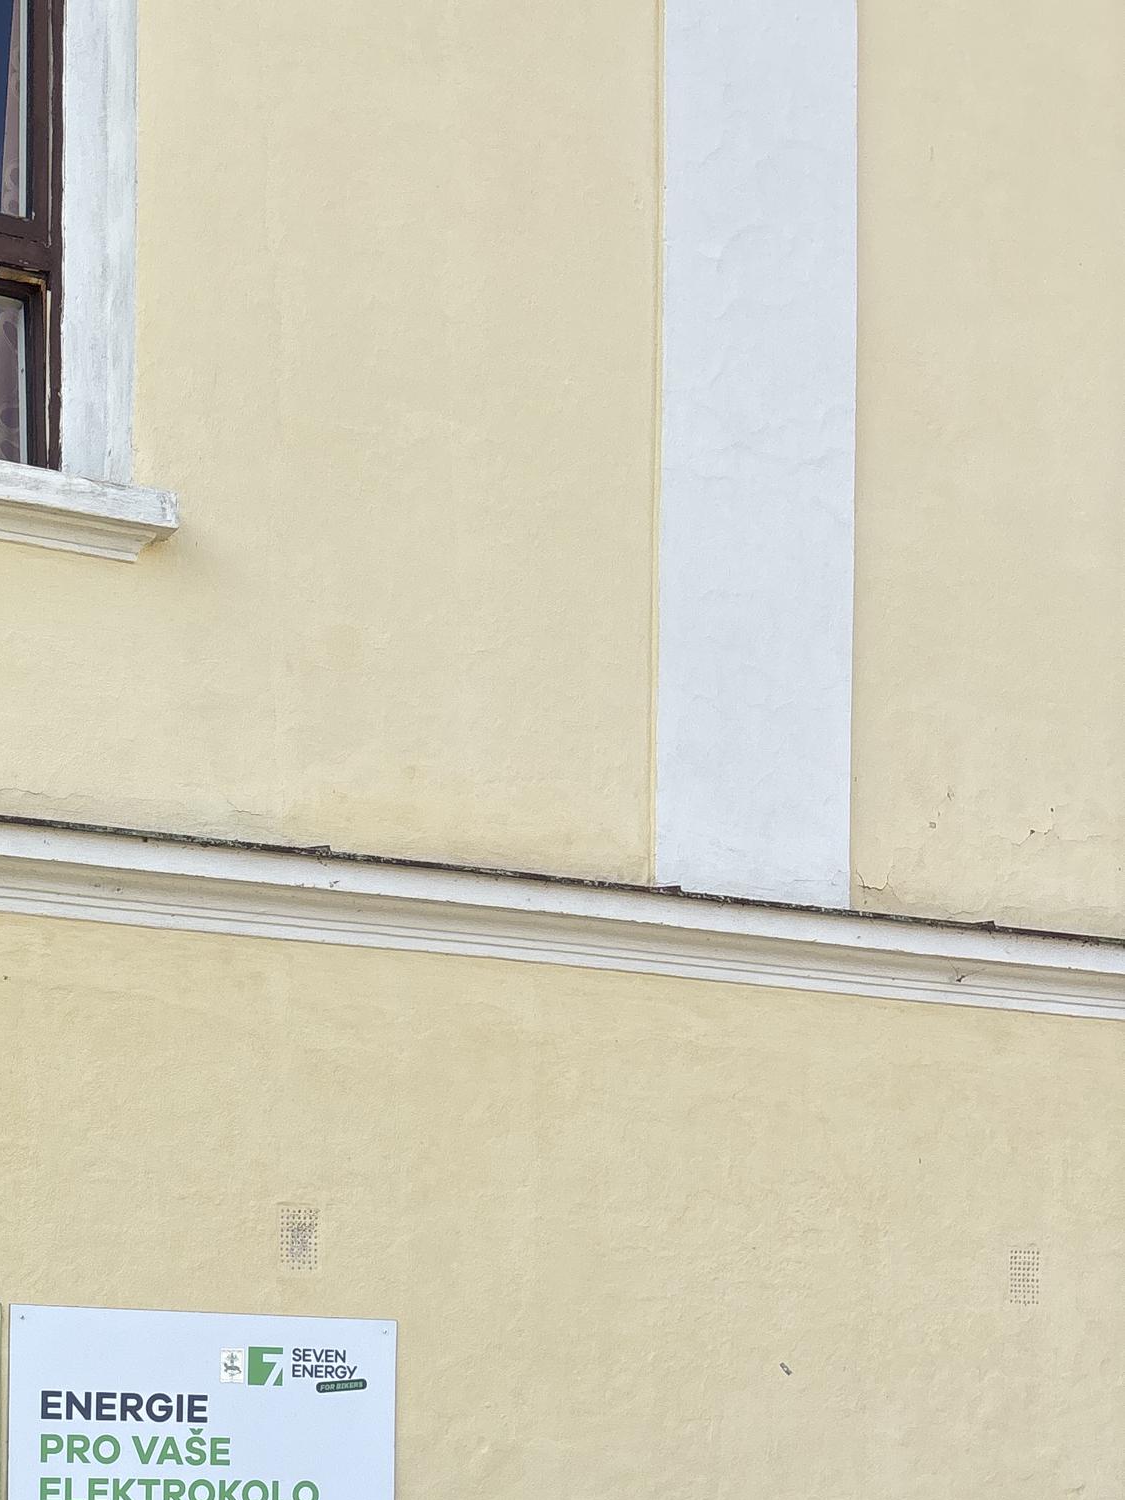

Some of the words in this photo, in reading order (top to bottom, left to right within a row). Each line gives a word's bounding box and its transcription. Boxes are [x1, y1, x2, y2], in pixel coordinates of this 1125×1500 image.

[292, 1364, 357, 1379] ENERGY
[320, 1383, 335, 1392] FOR
[336, 1381, 364, 1391] BIKERS
[40, 1390, 208, 1423] ENERGIE
[40, 1433, 121, 1465] PRO
[132, 1428, 231, 1466] VAŠE
